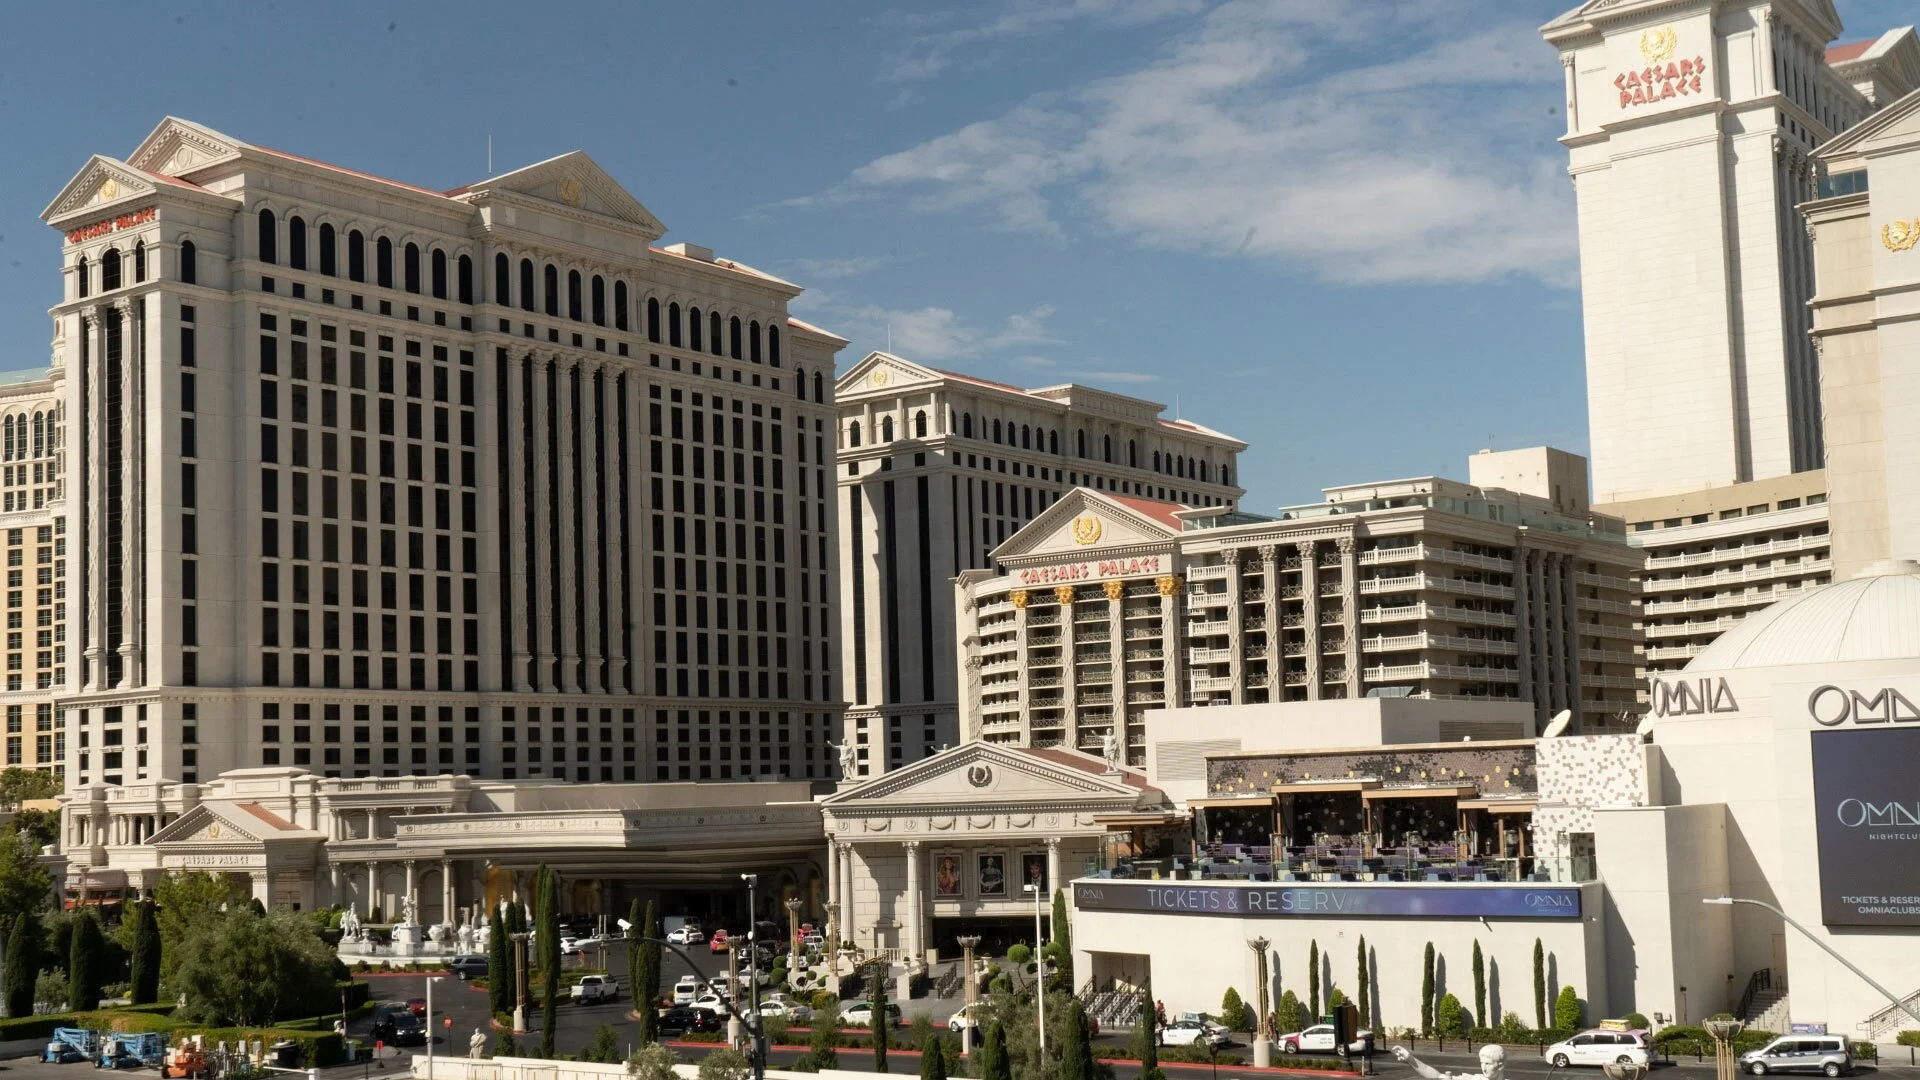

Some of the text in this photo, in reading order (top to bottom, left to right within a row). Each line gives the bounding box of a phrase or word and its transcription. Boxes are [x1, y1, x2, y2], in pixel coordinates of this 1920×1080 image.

[1614, 55, 1706, 91] CAESARS
[1619, 75, 1702, 109] PALACE
[67, 207, 155, 244] CAESARS PALACE
[1020, 557, 1159, 585] CAESARS PALACE
[1652, 677, 1740, 718] OMNIA
[1869, 833, 1920, 841] NIGHTCLU
[1147, 889, 1220, 909] TICKETS
[1227, 891, 1238, 910] &
[1524, 893, 1573, 907] OMNIA
[1841, 896, 1879, 904] TICKETS
[1880, 896, 1888, 904] &
